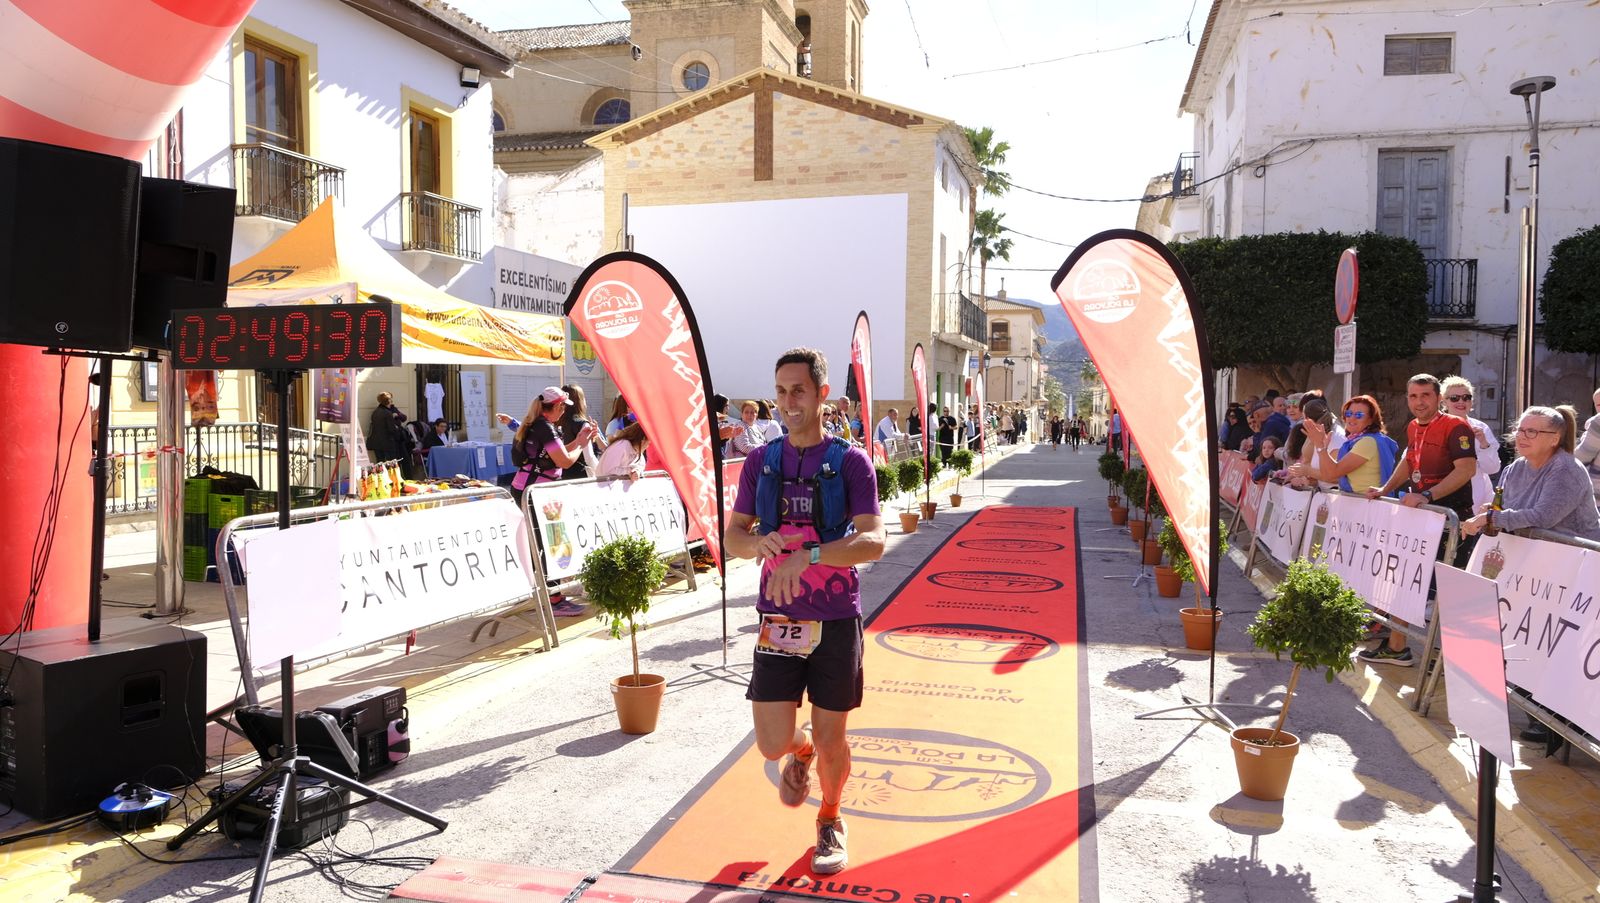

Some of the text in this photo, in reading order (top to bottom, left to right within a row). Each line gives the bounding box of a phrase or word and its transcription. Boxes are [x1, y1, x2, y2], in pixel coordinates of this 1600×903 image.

[500, 268, 567, 295] EXCELENTÍSIMO
[501, 292, 565, 316] AYUNTAMIENTO
[179, 309, 388, 363] 02:49:30
[573, 497, 657, 520] AYUNTAMENTO
[576, 509, 679, 548] CANTORIA
[339, 524, 508, 570] YUNTAMIENTO DE
[1412, 538, 1428, 556] DE
[340, 544, 519, 614] ANTORIA
[778, 625, 802, 640] 72
[863, 685, 1024, 704] Ayuntamiento
[881, 679, 1012, 695] de Cantoria
[847, 741, 1016, 765] LA POLVOR
[738, 870, 901, 903] Cantoria
